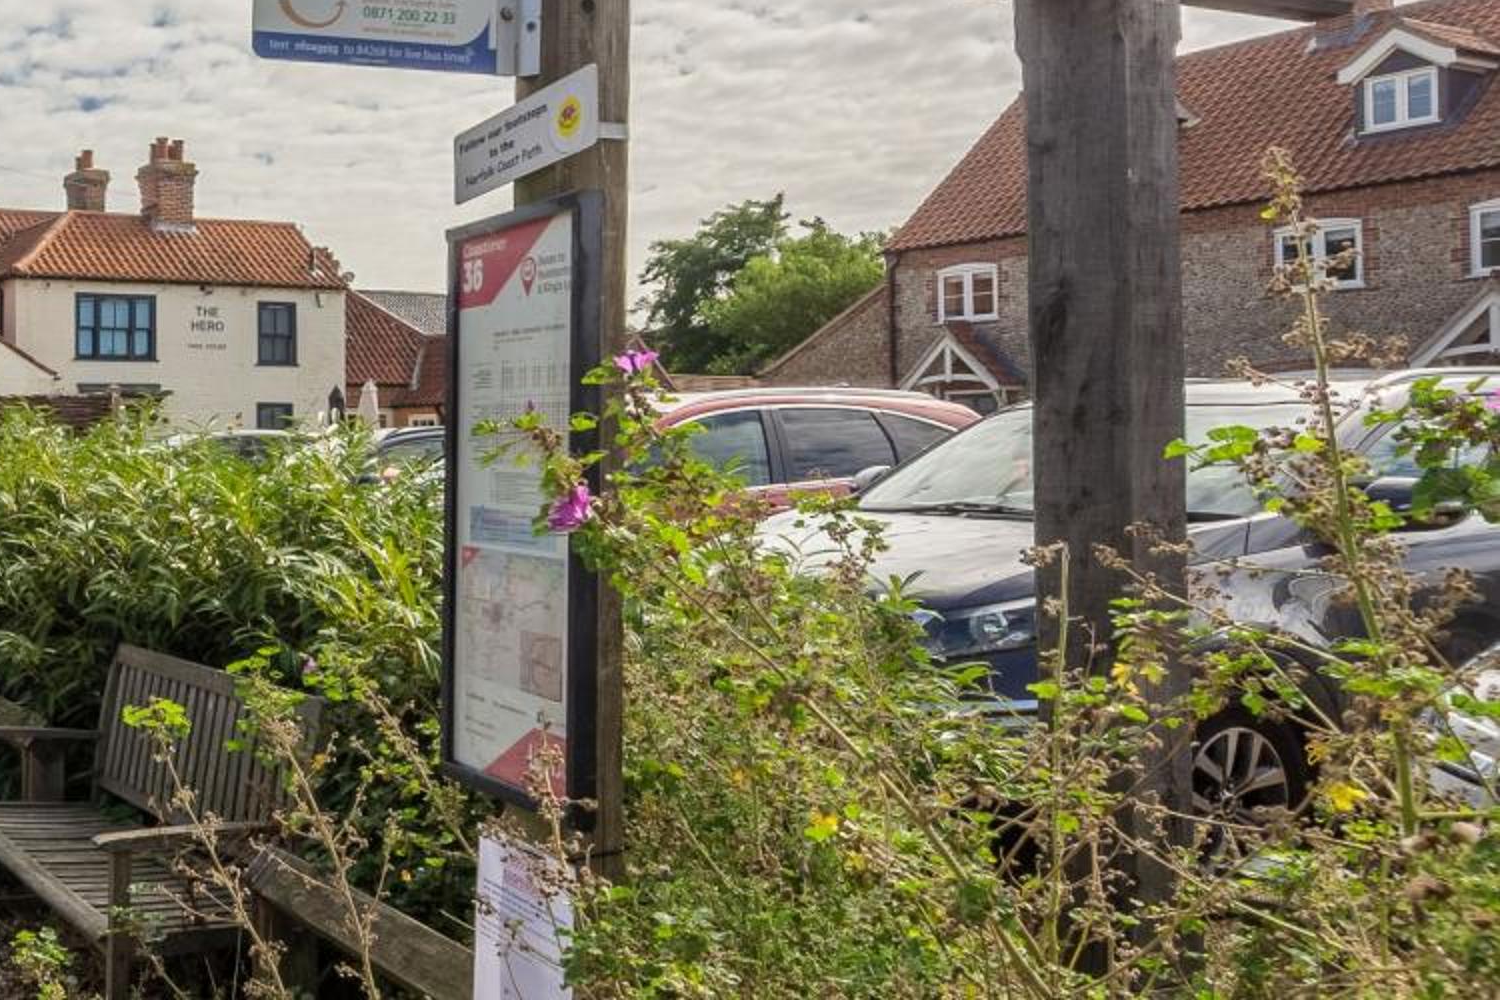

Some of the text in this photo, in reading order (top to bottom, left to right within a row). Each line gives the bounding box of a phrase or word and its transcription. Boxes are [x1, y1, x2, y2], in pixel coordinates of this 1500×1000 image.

[363, 5, 456, 25] 0871 200 22 33
[500, 139, 515, 152] the
[462, 258, 484, 294] 36
[196, 305, 219, 318] THE
[190, 319, 225, 332] HERO
